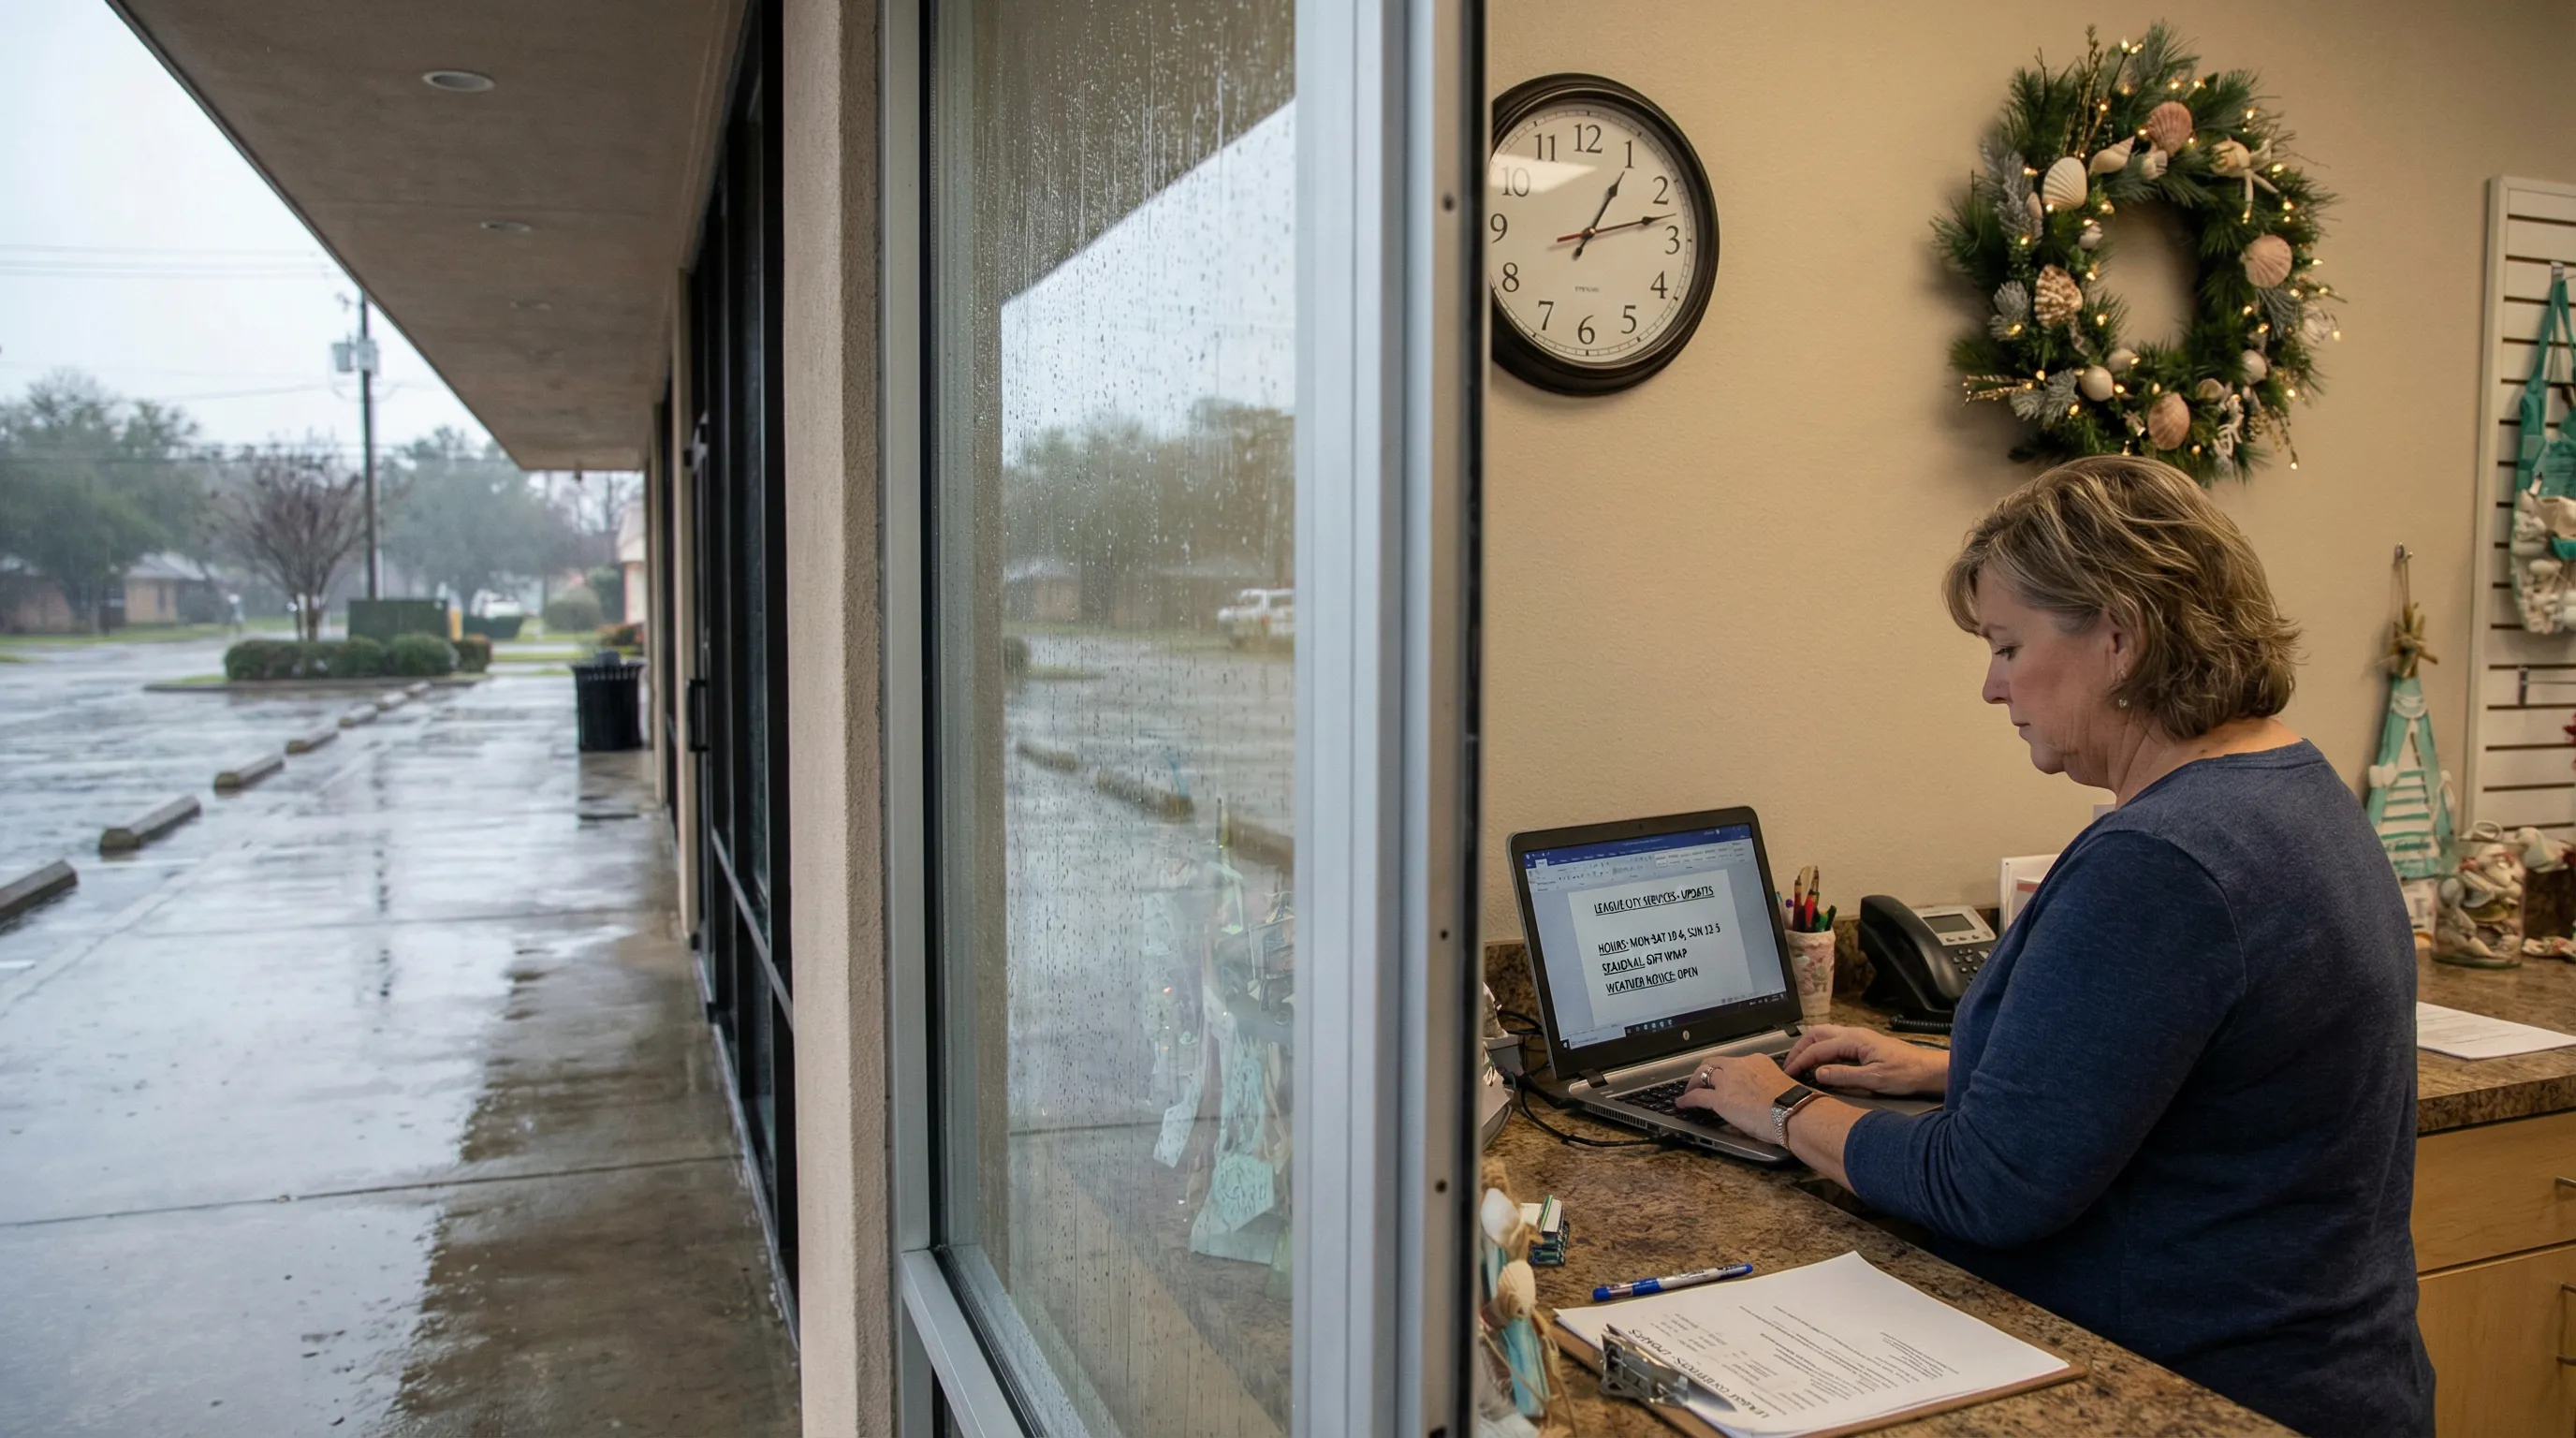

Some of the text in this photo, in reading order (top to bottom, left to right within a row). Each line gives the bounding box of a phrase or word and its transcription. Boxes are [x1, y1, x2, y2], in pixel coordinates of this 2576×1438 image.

[1534, 133, 1558, 163] 11
[1573, 124, 1603, 154] 12
[1624, 140, 1634, 169] 1
[1500, 166, 1531, 198] 10
[1653, 176, 1669, 205] 2
[1490, 213, 1508, 243] 9
[1664, 226, 1680, 256] 3
[1501, 262, 1520, 292] 8
[1650, 271, 1668, 299] 4
[1537, 300, 1555, 330] 7
[1577, 315, 1596, 345] 6
[1621, 305, 1637, 334] 5
